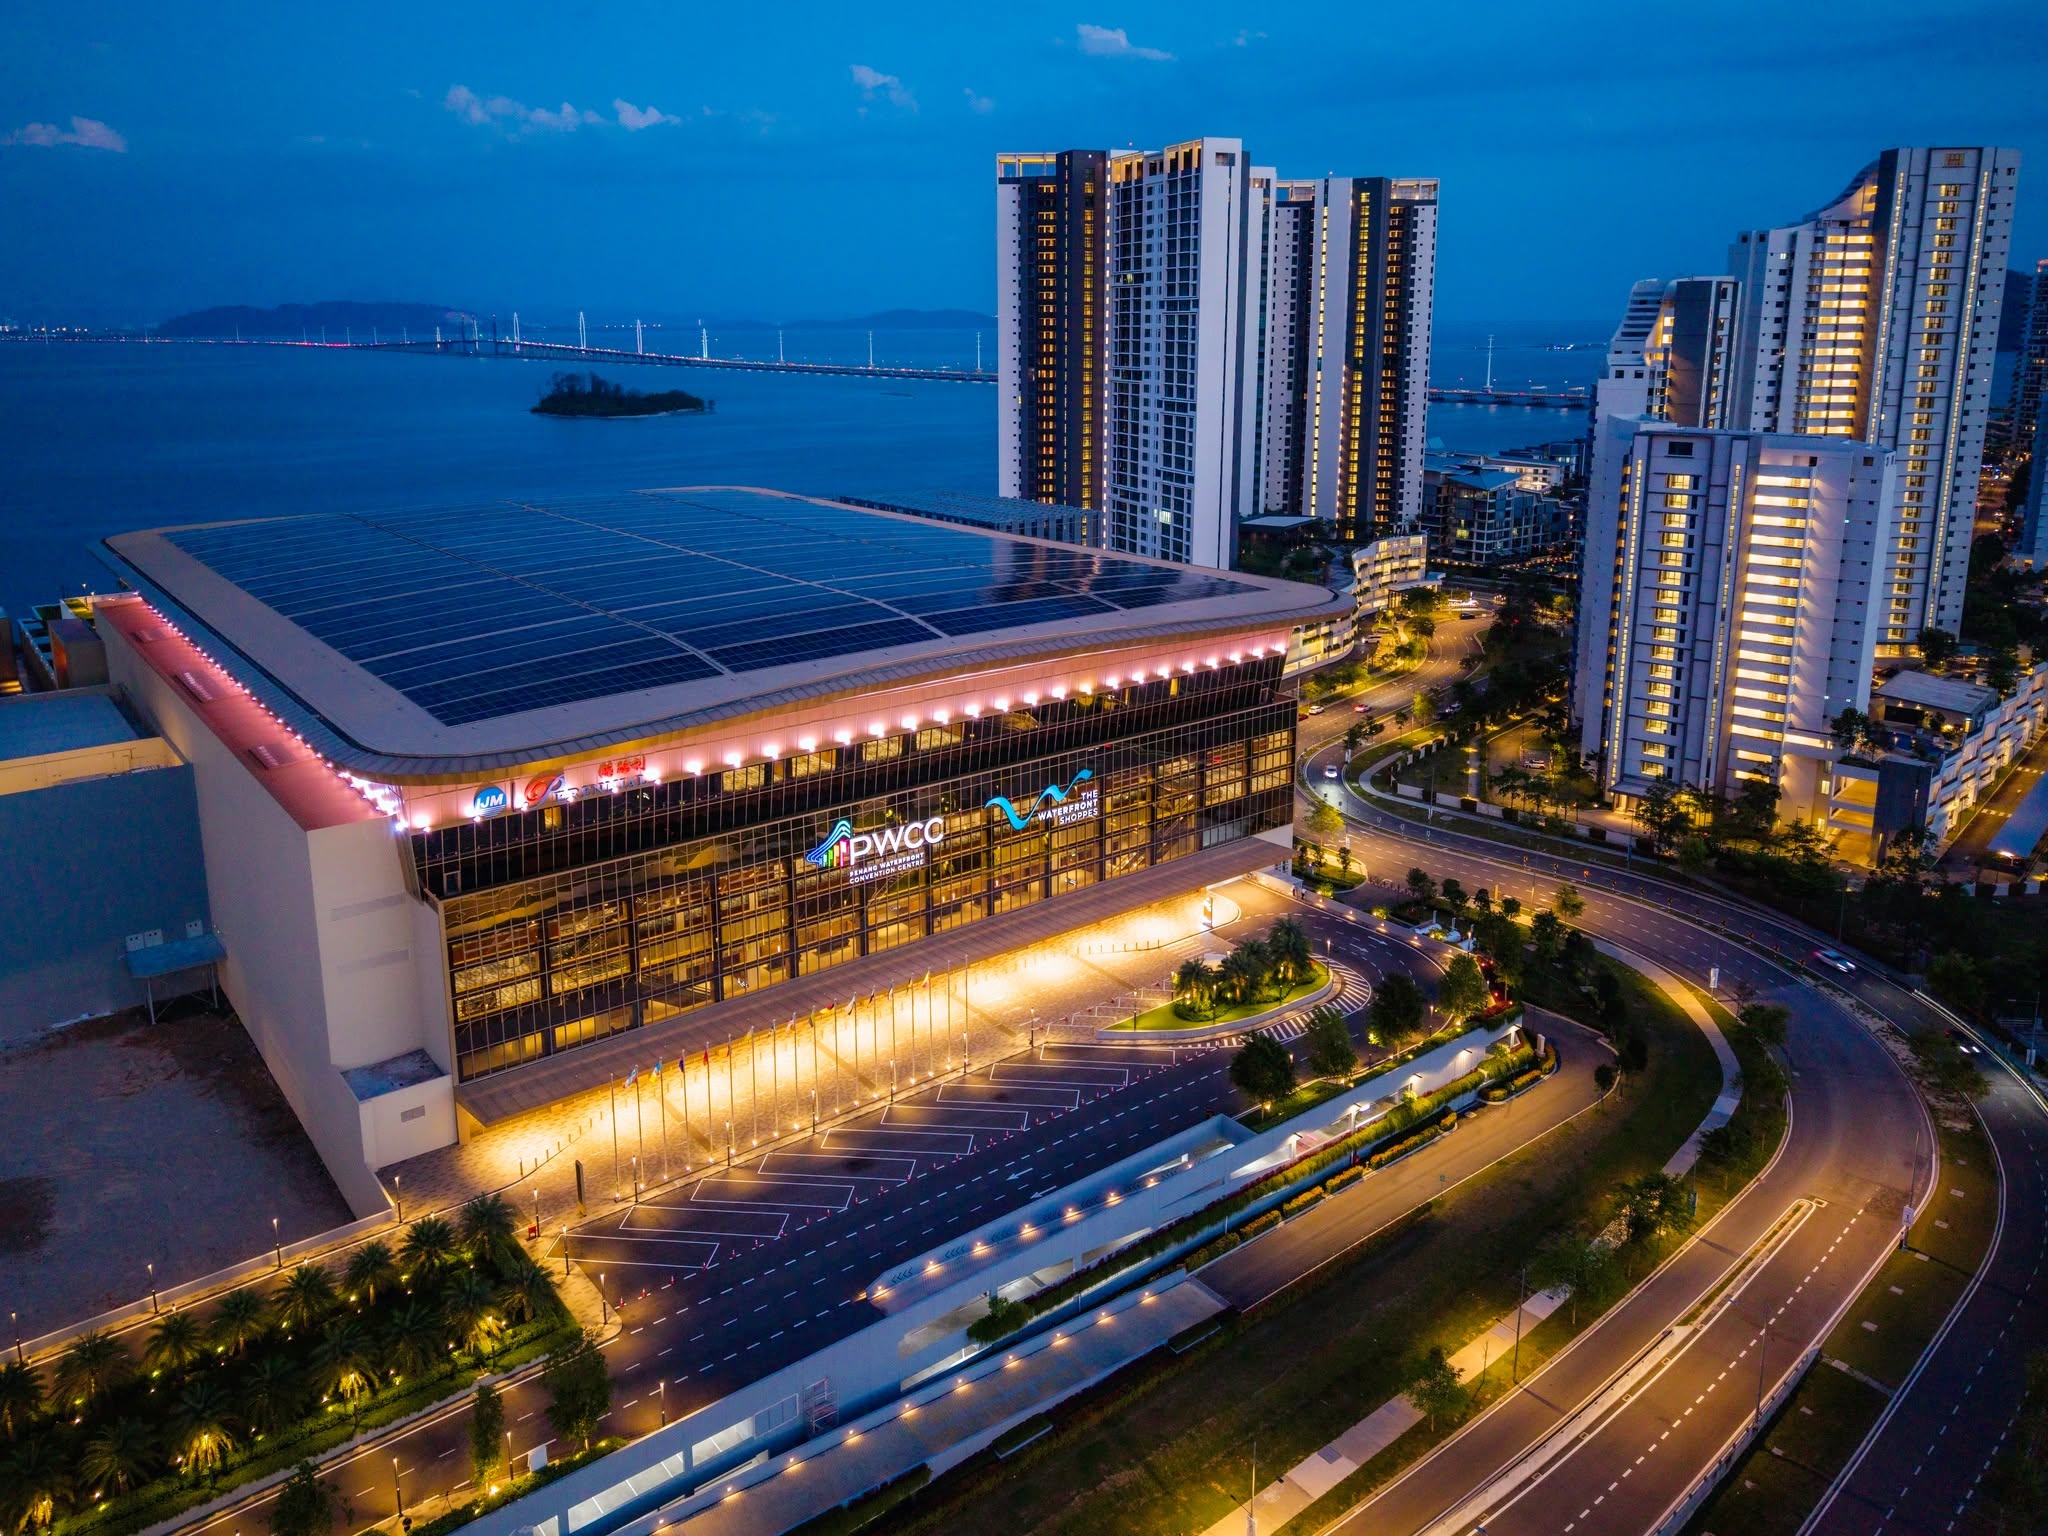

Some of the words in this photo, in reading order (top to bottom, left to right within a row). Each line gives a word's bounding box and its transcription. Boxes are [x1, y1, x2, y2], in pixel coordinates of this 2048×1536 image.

[476, 793, 504, 808] IJM
[1081, 789, 1098, 800] THE
[1038, 799, 1098, 820] WATERFRONT
[1060, 808, 1098, 824] SHOPPES
[849, 817, 944, 866] PWCC
[880, 852, 924, 869] WATERFRONT
[849, 866, 896, 884] CONVENTION
[897, 860, 924, 871] CENTRE
